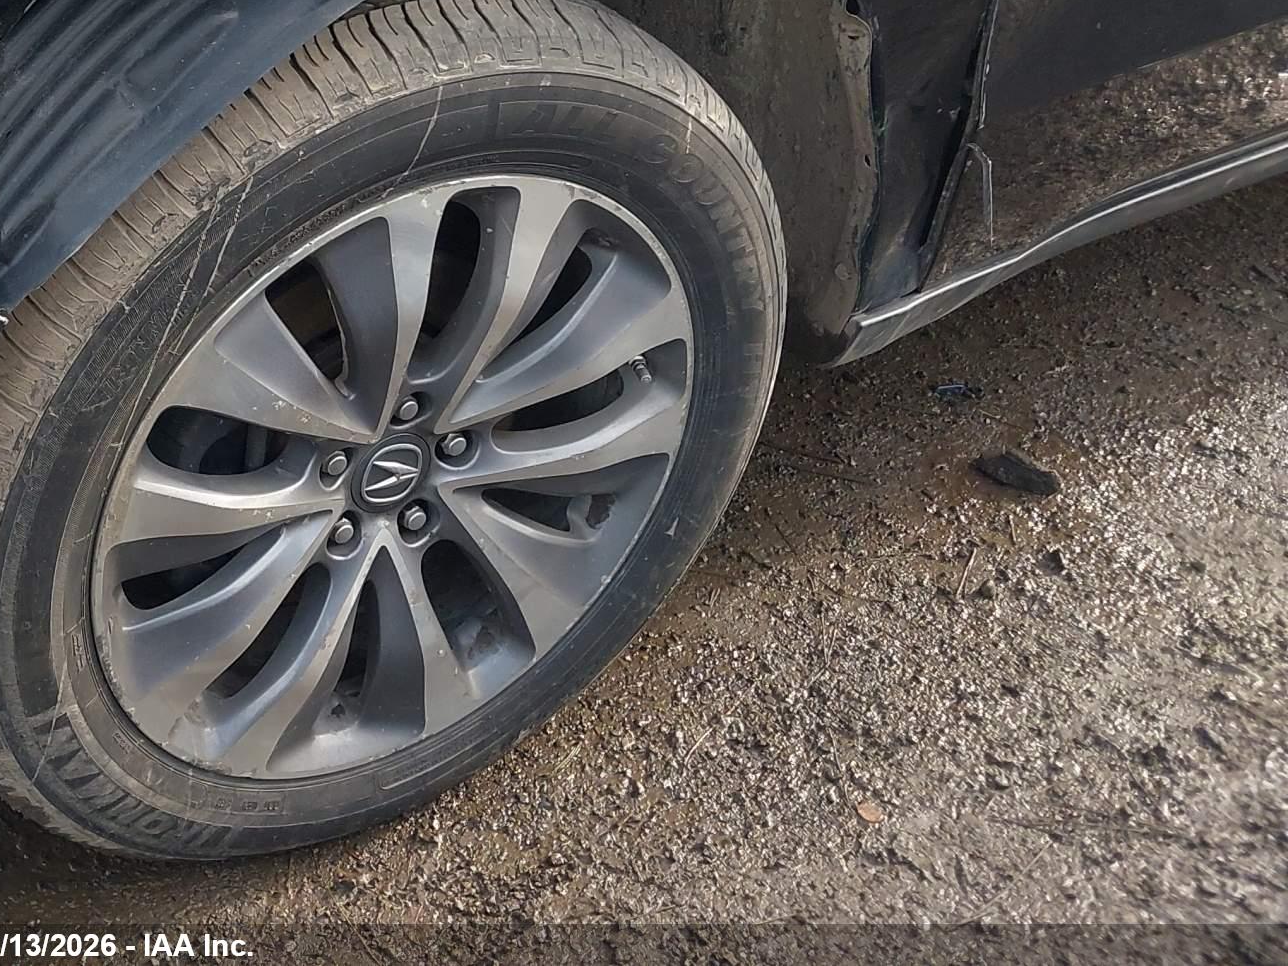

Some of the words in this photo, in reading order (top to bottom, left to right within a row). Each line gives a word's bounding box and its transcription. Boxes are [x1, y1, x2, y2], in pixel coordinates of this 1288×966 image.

[511, 102, 622, 143] ALL
[640, 133, 765, 313] COUNTRY
[32, 713, 232, 848] IRONMAN
